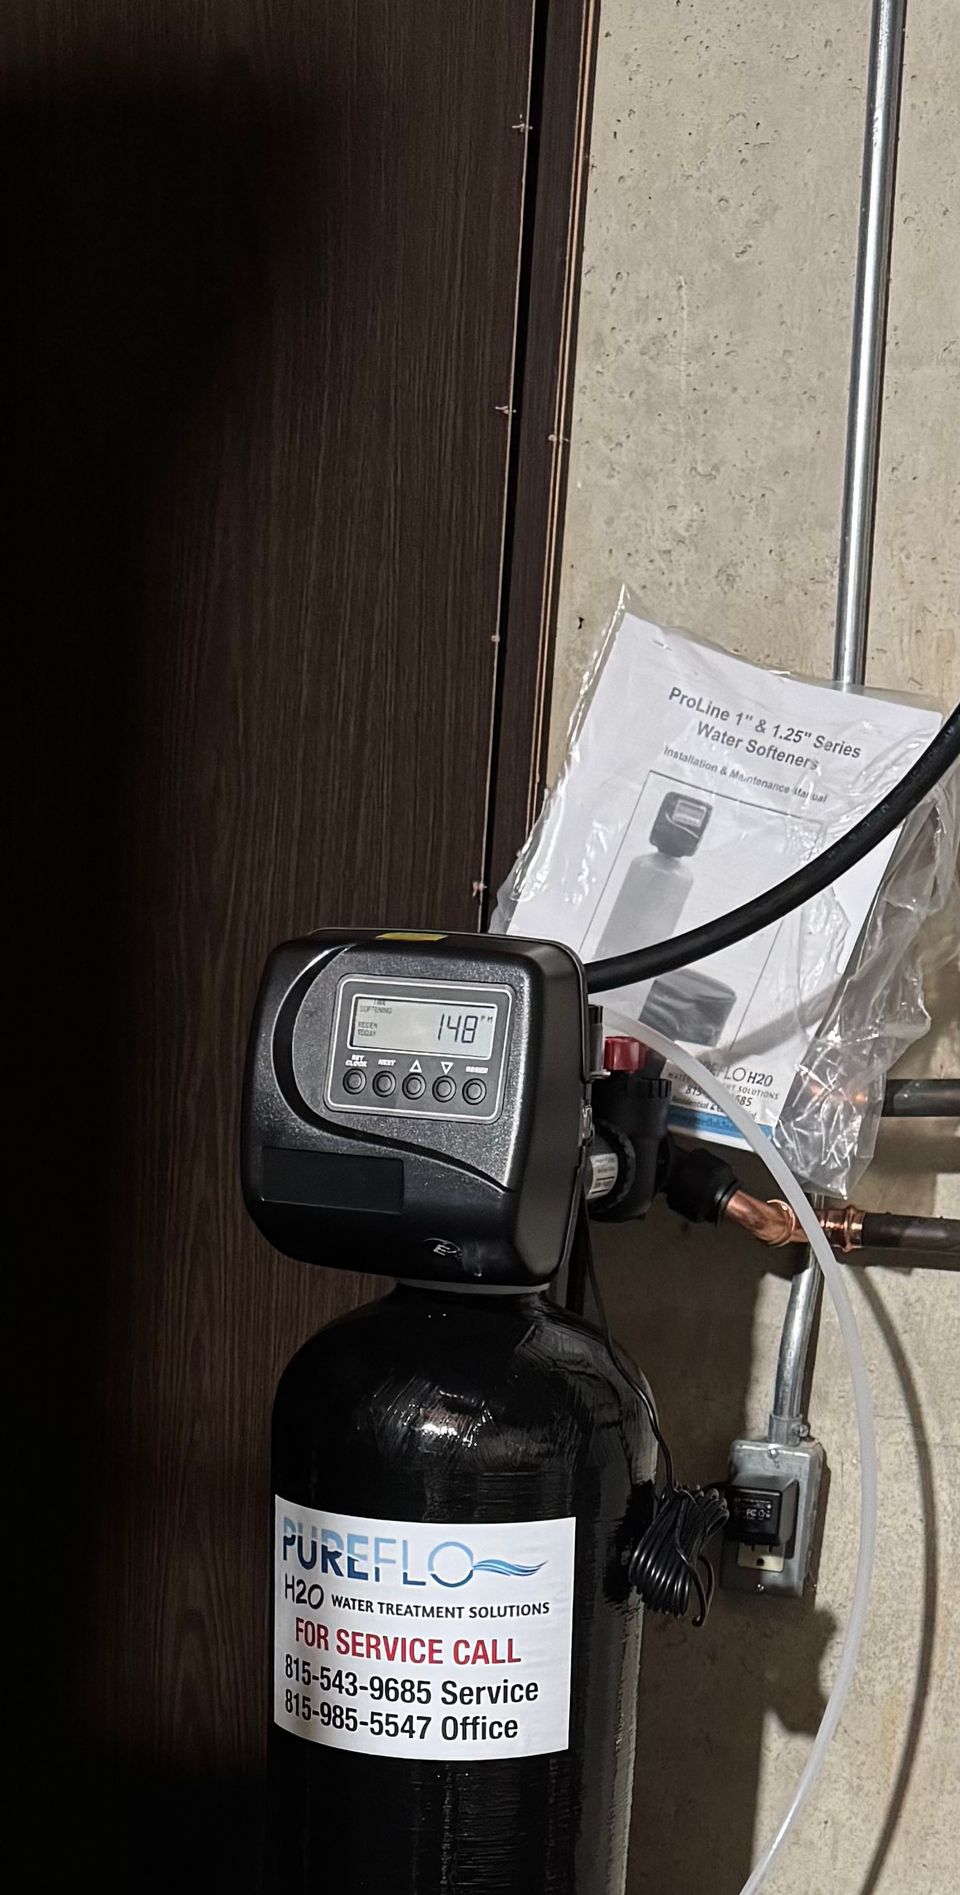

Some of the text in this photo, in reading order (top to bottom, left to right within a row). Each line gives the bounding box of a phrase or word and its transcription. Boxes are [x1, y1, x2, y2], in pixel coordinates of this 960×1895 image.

[668, 686, 862, 759] ProLine 1" & 1.25" Series
[697, 721, 820, 771] Water Softeners
[664, 746, 718, 773] Installation
[720, 766, 727, 776] &
[282, 1516, 475, 1588] PUREFLO
[284, 1573, 550, 1619] H2O WATER TREATMENT SOLUTIONS
[295, 1616, 522, 1666] FOR SERVICE CALL
[284, 1653, 539, 1706] 815-543-9685 Service
[284, 1688, 519, 1741] 815-985-5547 Office
